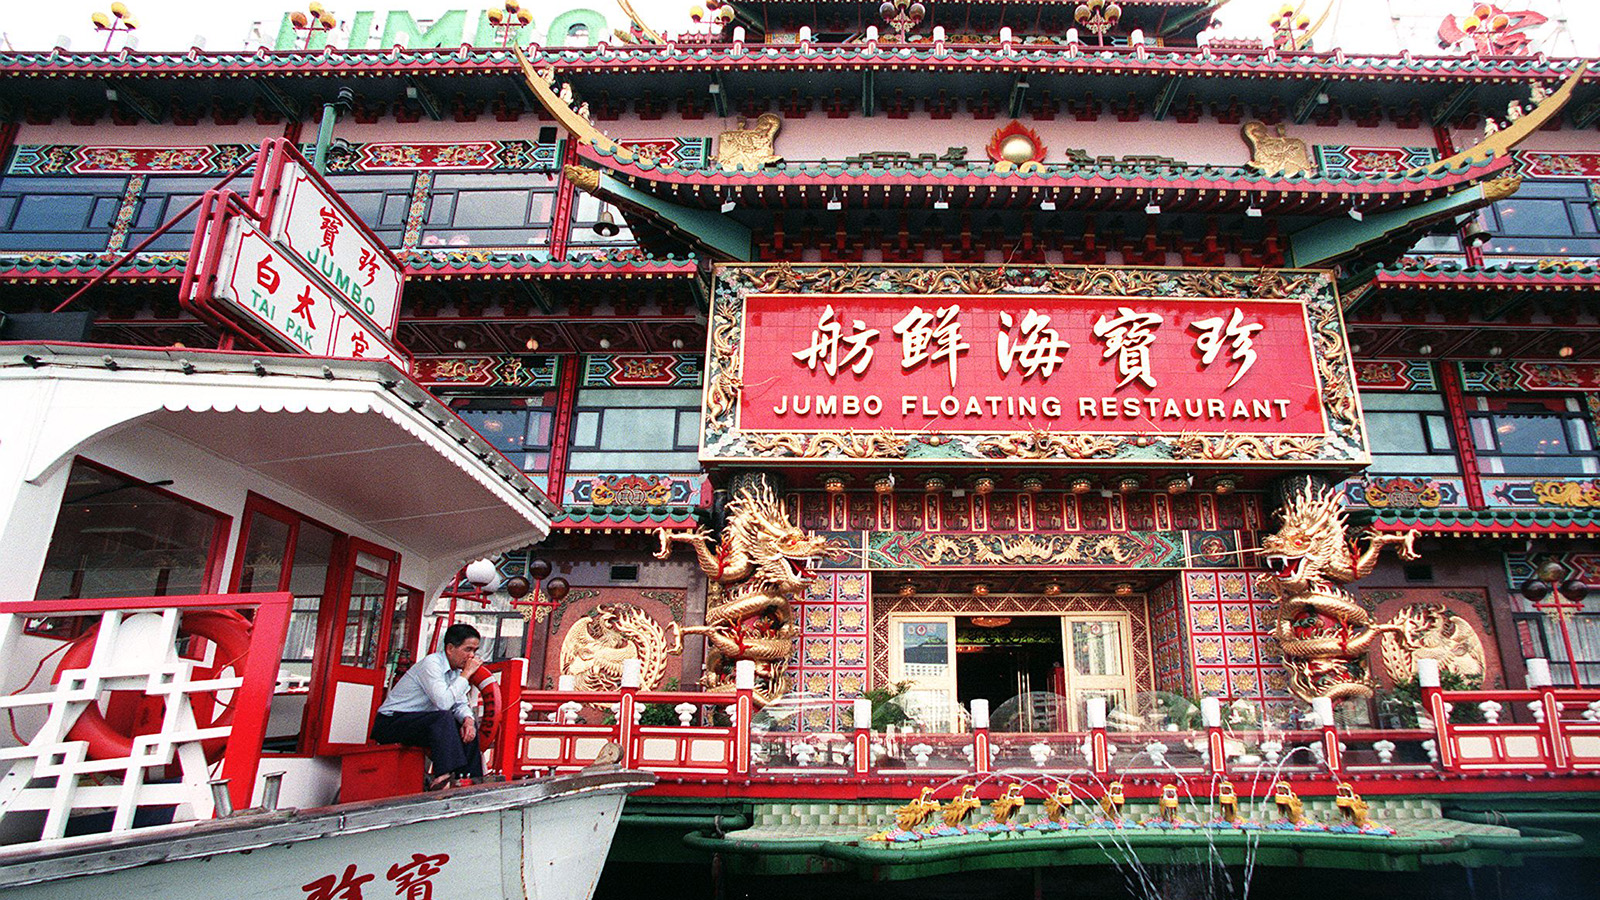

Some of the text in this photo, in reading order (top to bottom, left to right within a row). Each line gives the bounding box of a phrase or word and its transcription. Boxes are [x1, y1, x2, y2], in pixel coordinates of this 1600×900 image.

[306, 247, 376, 316] JUMBO
[251, 289, 315, 351] TAI PAK
[773, 394, 1291, 420] JUMBO FLOATING RESTAURANT
